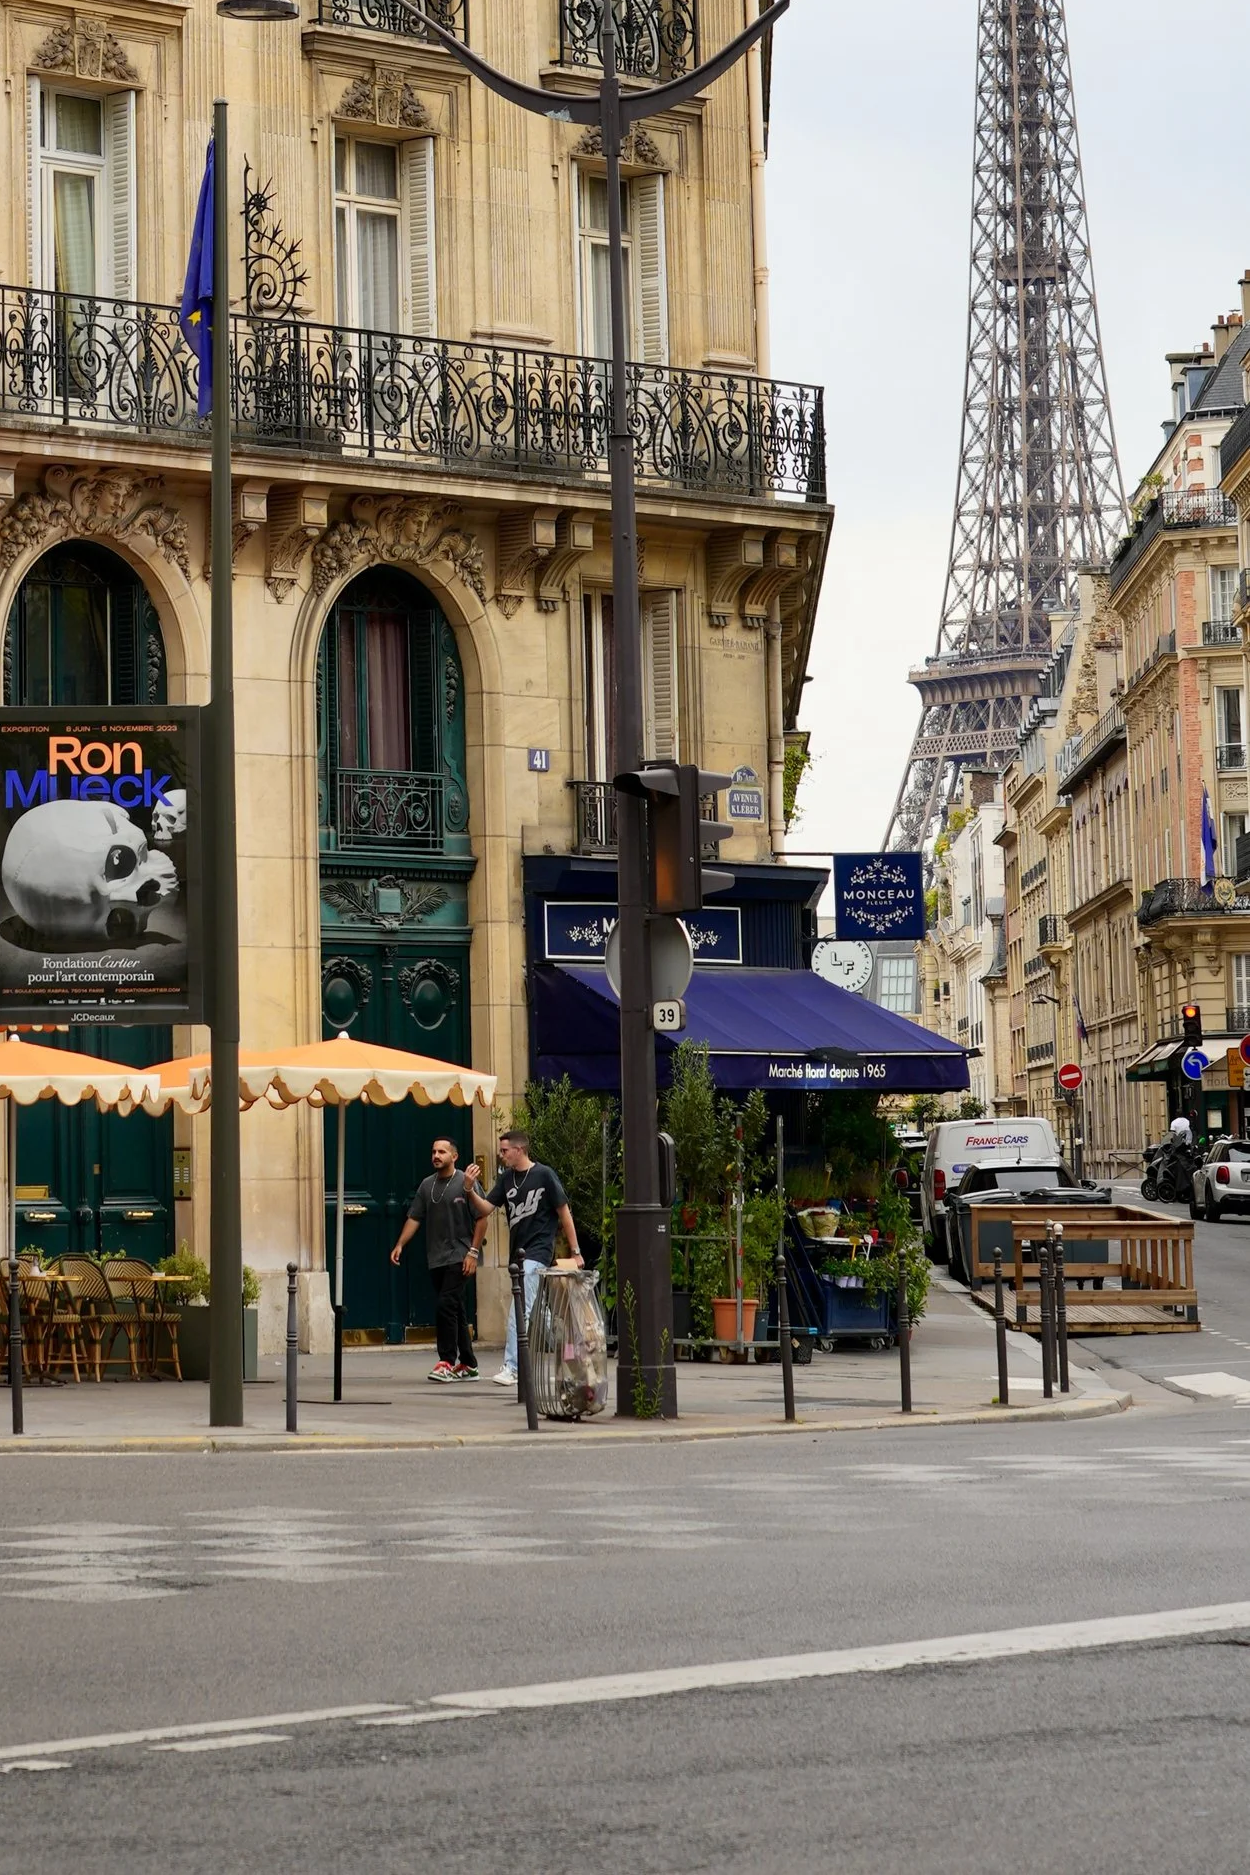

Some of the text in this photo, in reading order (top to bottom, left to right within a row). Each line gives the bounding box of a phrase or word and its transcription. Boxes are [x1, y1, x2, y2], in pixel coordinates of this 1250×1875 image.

[66, 725, 72, 733] 8
[109, 725, 155, 733] NOVEMBRE
[49, 736, 143, 775] Ron
[533, 750, 546, 769] 41
[5, 769, 174, 809] Mueck
[732, 792, 759, 804] AVENUE
[731, 803, 760, 815] KLÉBER
[843, 889, 915, 900] MONCEAU
[28, 975, 55, 985] pour
[78, 971, 155, 985] contemporain
[71, 1013, 115, 1022] JCDecaux
[659, 1009, 675, 1022] 39
[769, 1063, 886, 1082] Marché floral depuis 1965
